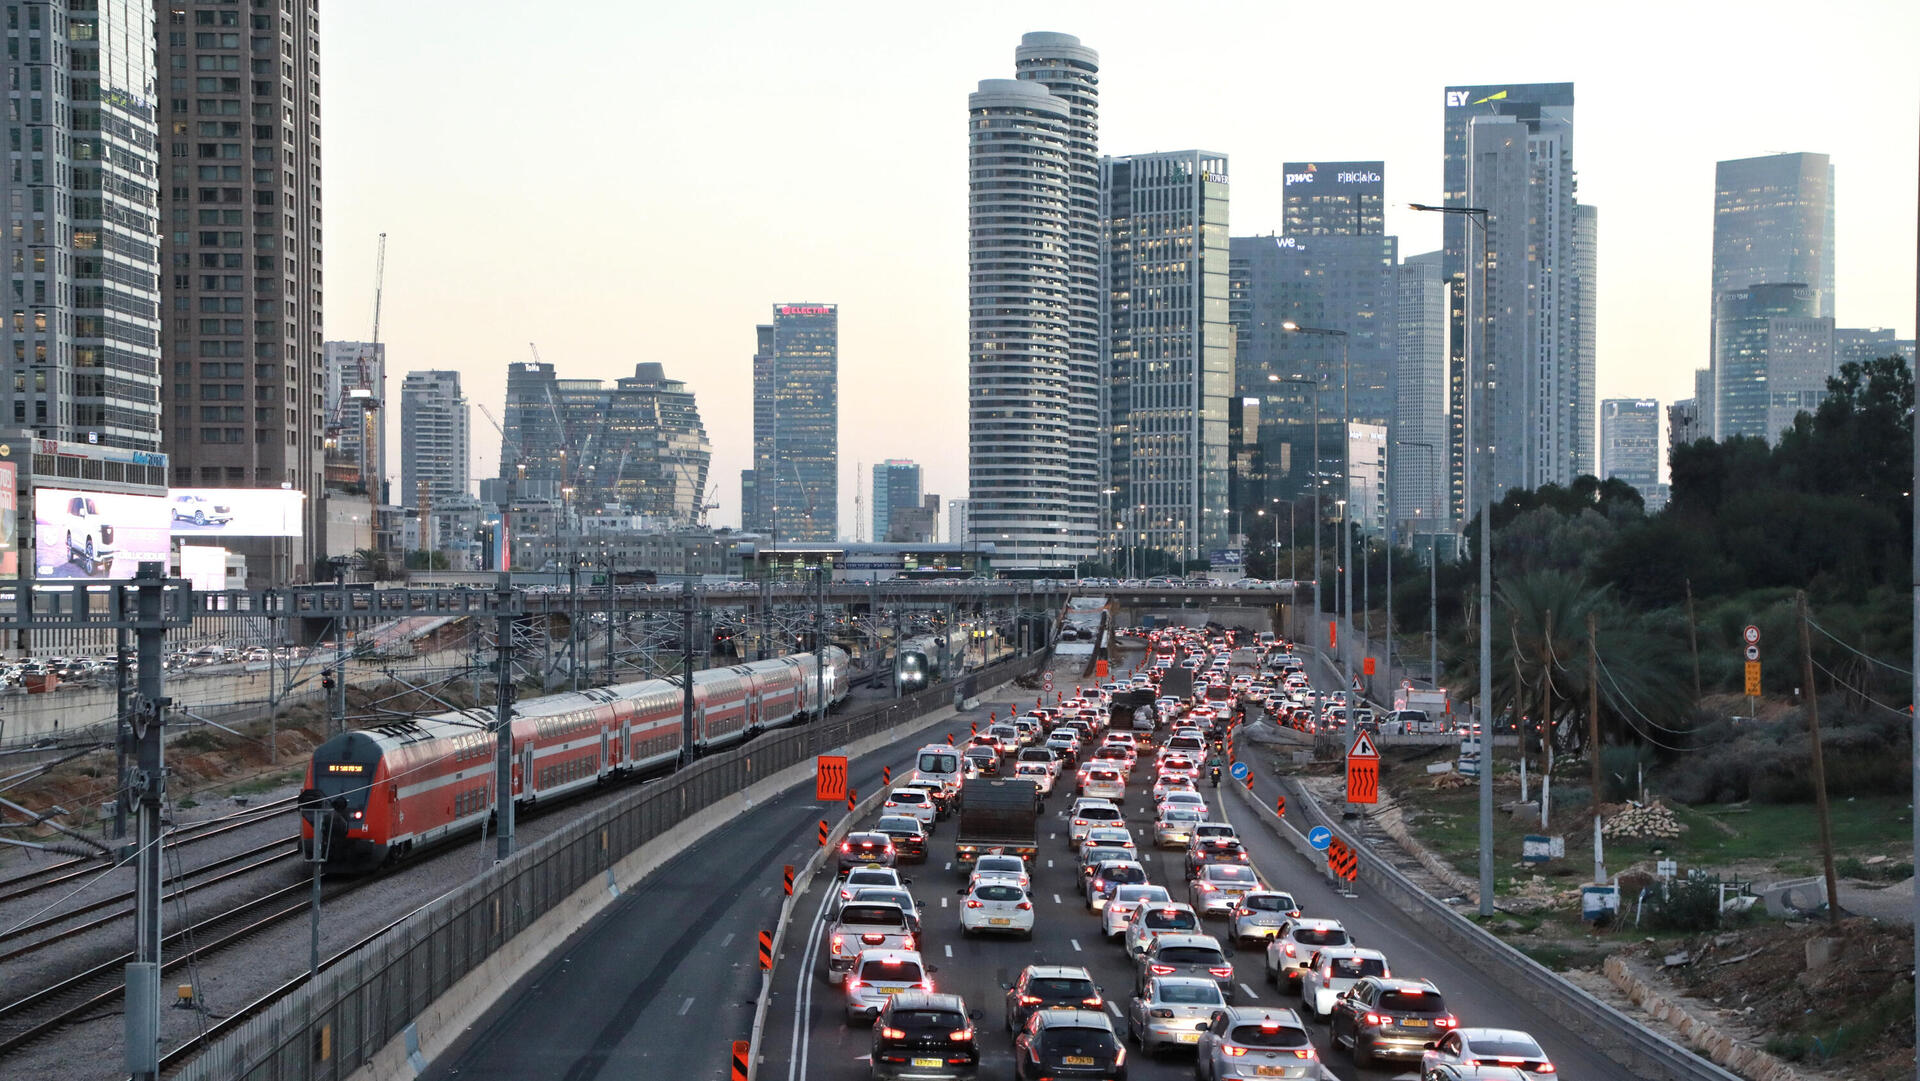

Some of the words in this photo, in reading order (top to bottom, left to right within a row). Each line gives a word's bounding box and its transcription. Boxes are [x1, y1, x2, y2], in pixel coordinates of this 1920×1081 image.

[1447, 91, 1470, 107] EY
[1209, 173, 1229, 185] TOWER
[1286, 173, 1314, 186] pwc
[1276, 238, 1296, 248] we
